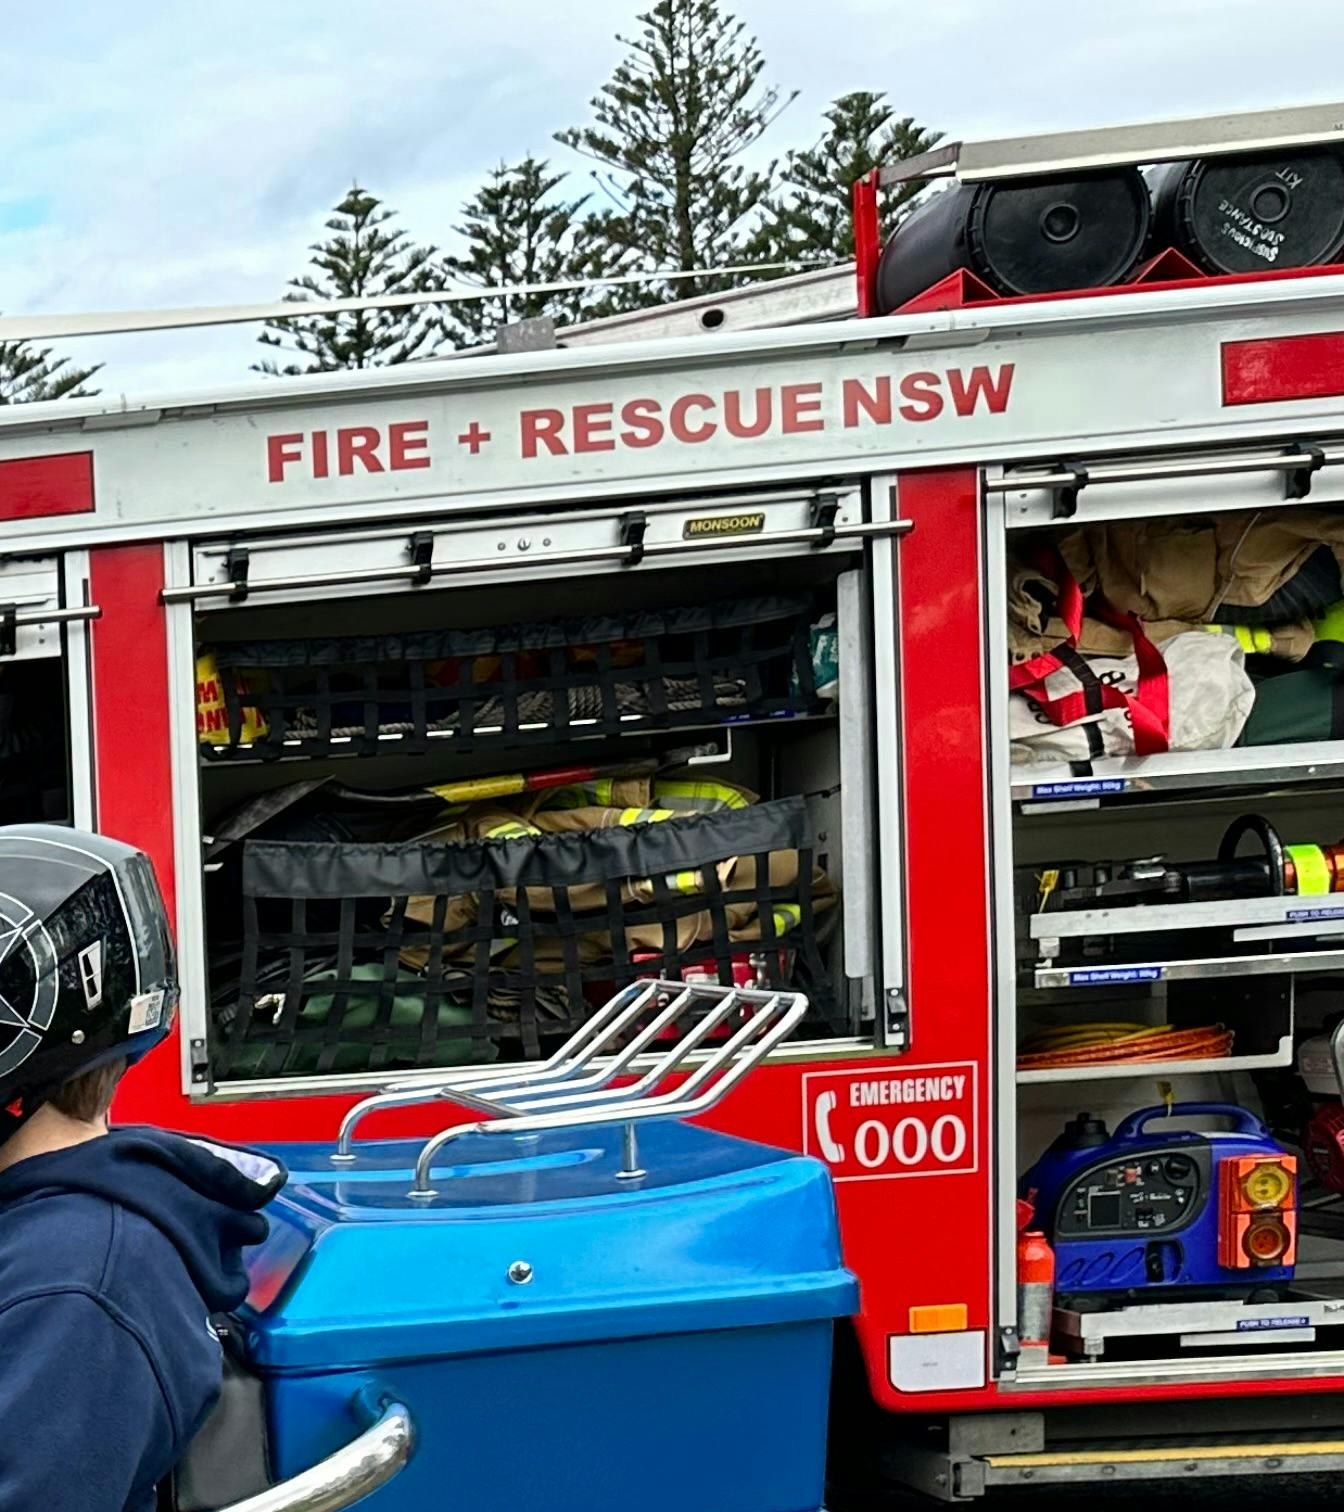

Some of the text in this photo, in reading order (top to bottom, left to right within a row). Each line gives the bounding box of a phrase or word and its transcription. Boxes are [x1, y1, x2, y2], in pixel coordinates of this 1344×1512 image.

[1275, 166, 1304, 190] KIT
[267, 420, 431, 483] FIRE
[520, 383, 824, 459] RESCUE
[842, 363, 1016, 428] NSW
[690, 516, 760, 532] MONSOON
[850, 1075, 966, 1107] EMERGENCY
[854, 1114, 967, 1168] 000
